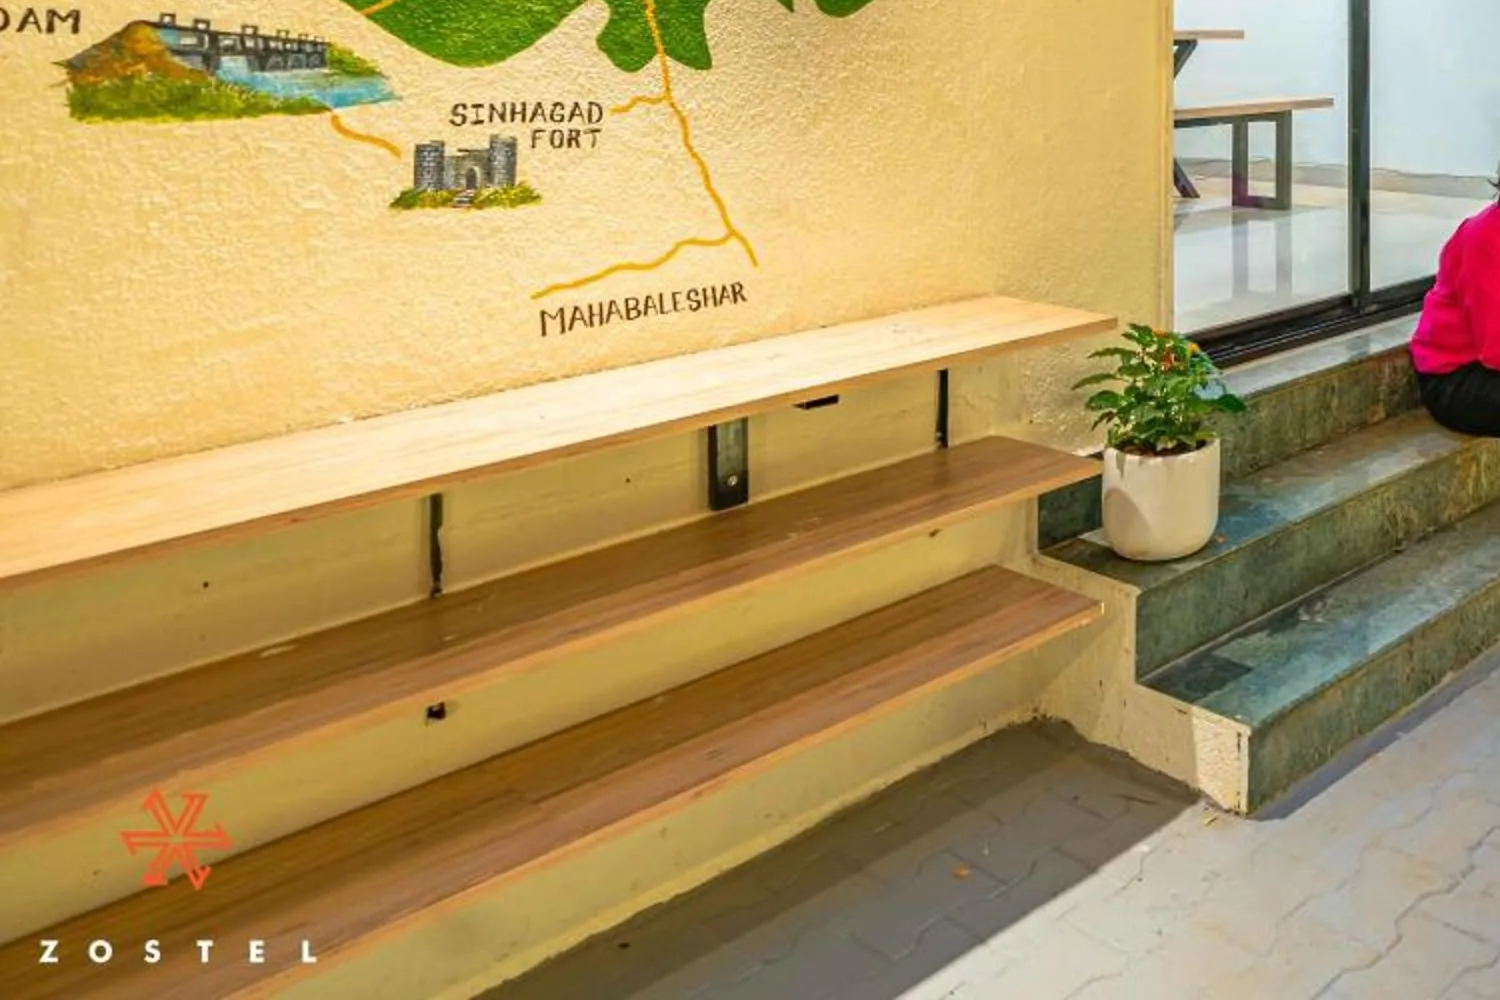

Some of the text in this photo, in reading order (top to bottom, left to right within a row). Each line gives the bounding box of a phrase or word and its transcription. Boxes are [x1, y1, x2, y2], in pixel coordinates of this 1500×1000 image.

[448, 101, 604, 127] SINHAGAD
[530, 128, 603, 150] FORT
[538, 280, 748, 337] MAHABALESHAR
